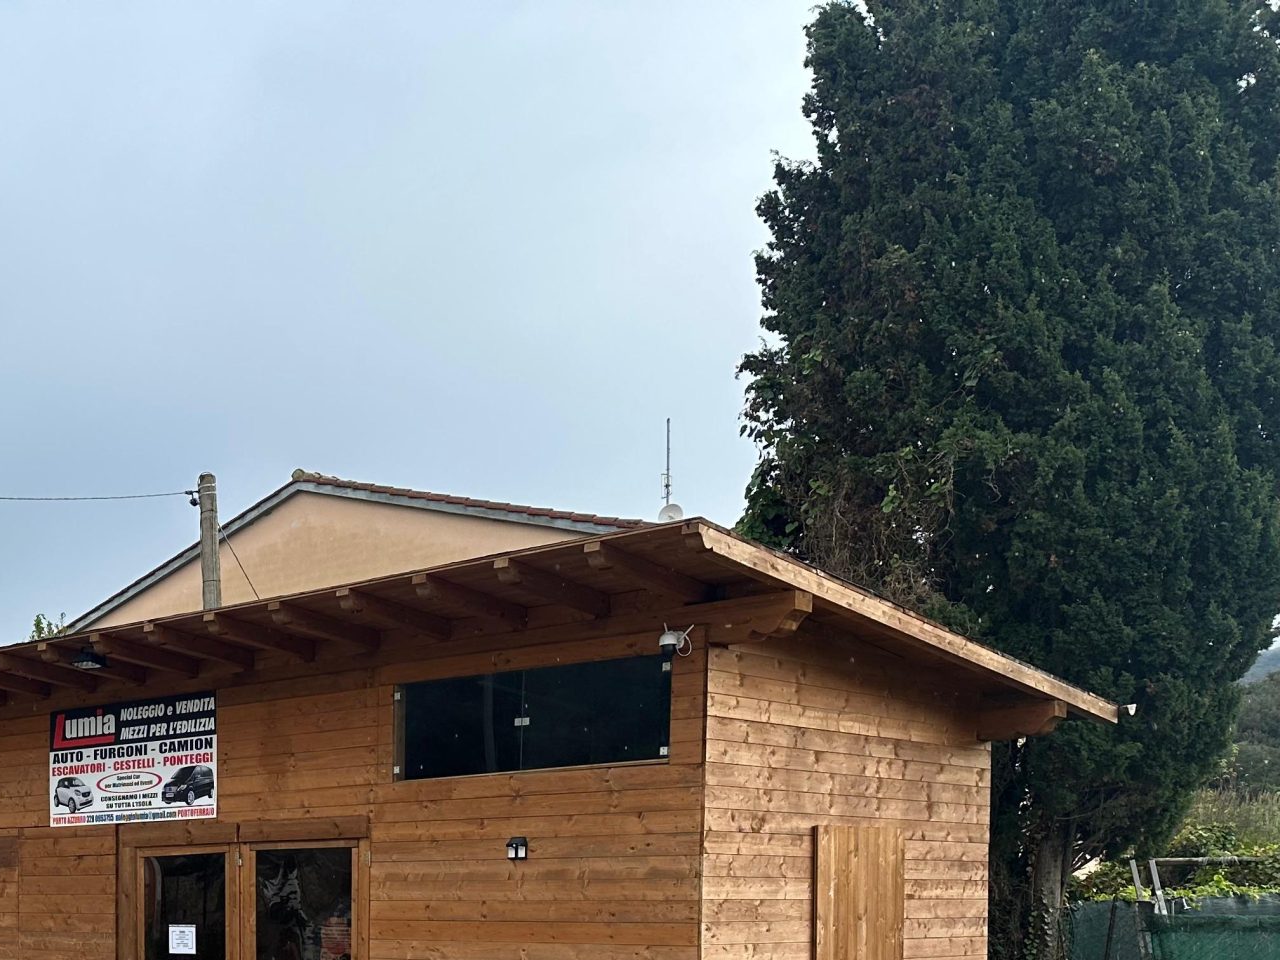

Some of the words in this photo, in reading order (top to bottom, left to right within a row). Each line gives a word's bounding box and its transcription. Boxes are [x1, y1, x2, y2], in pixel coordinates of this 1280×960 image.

[120, 703, 165, 721] NOLEGGIO
[167, 705, 173, 715] e
[176, 697, 215, 714] VENDITA
[53, 709, 116, 749] Lumia
[120, 725, 148, 740] MEZZI
[149, 722, 167, 737] PER
[169, 717, 215, 735] L'EDILIZIA
[52, 751, 83, 764] AUTO
[93, 744, 148, 760] FURGONI
[159, 736, 213, 754] CAMION
[52, 762, 106, 776] ESCAVATORI
[113, 758, 155, 771] CESTELLI
[163, 752, 213, 766] PONTEGGI
